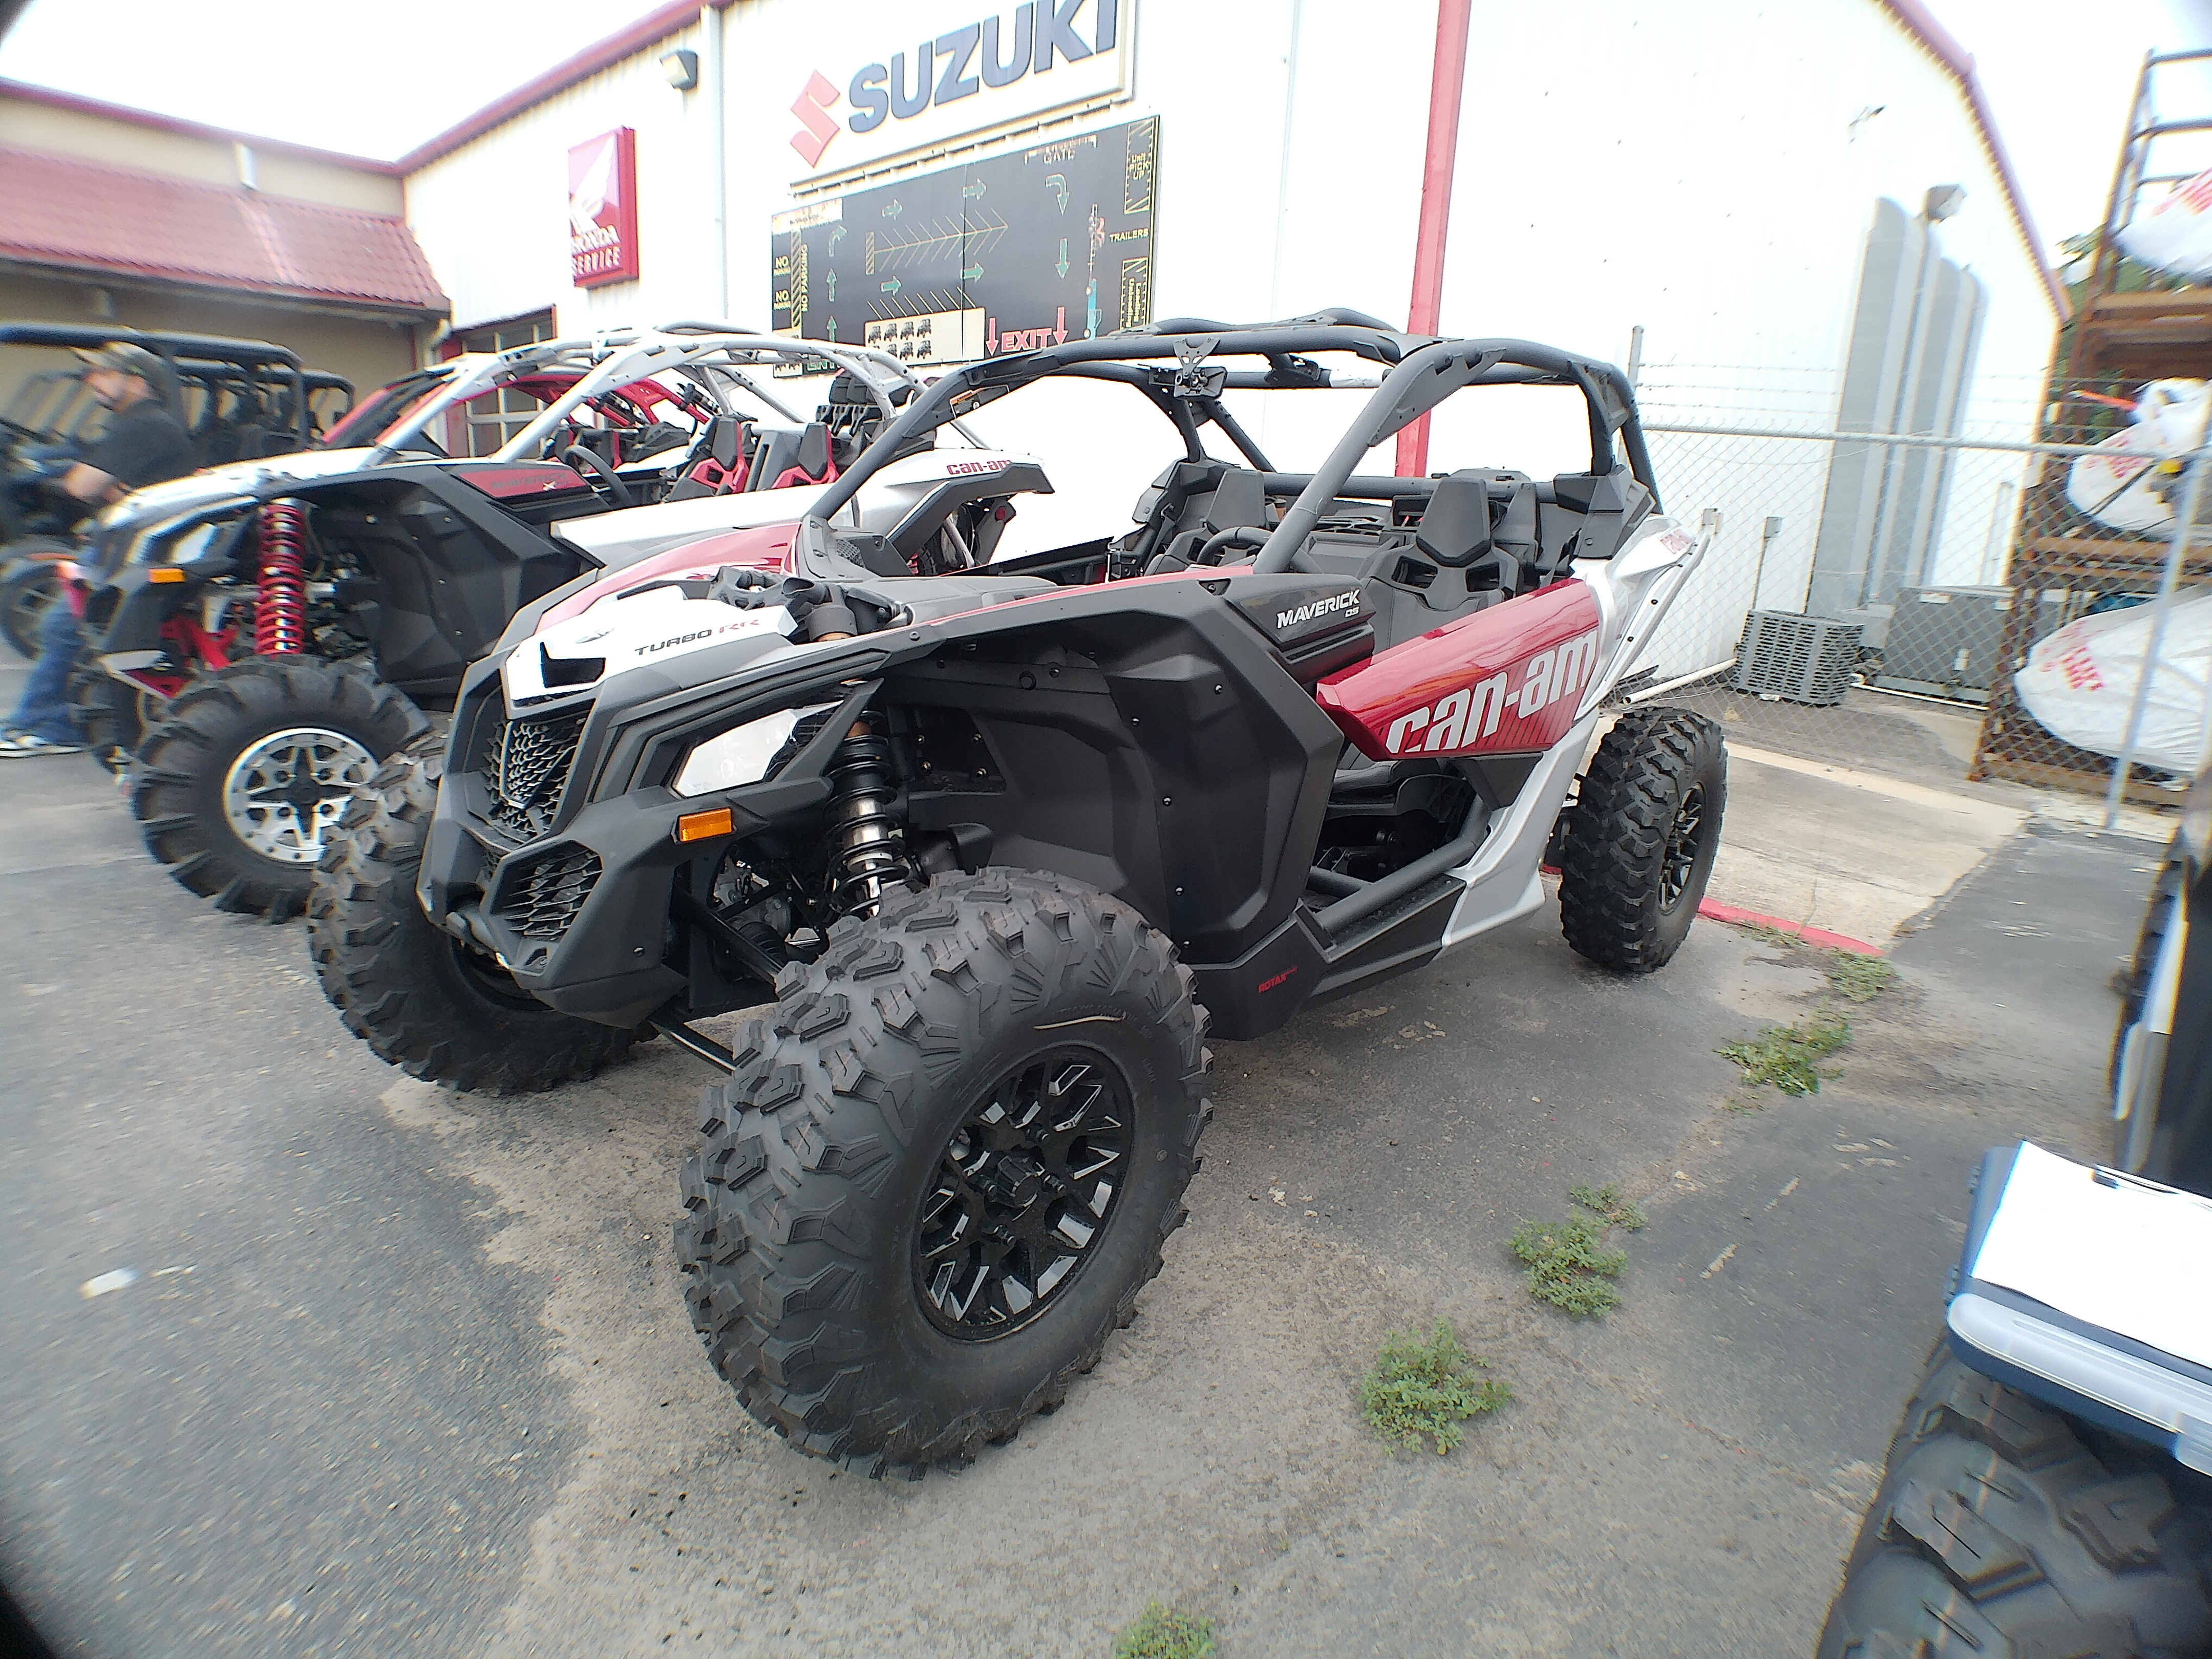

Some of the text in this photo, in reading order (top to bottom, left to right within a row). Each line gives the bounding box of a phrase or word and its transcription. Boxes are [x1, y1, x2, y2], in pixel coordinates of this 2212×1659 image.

[848, 0, 1117, 133] SUZUKI
[1129, 160, 1148, 173] PICK
[1133, 170, 1144, 180] UP
[1110, 228, 1148, 243] TRAILERS
[775, 256, 789, 269] NO
[801, 244, 809, 313] NO PARKING
[775, 290, 790, 302] NO
[1001, 328, 1053, 353] EXIT
[1277, 589, 1360, 629] MAVERICK
[634, 619, 760, 656] TURBO RR
[1386, 630, 1598, 754] can-am
